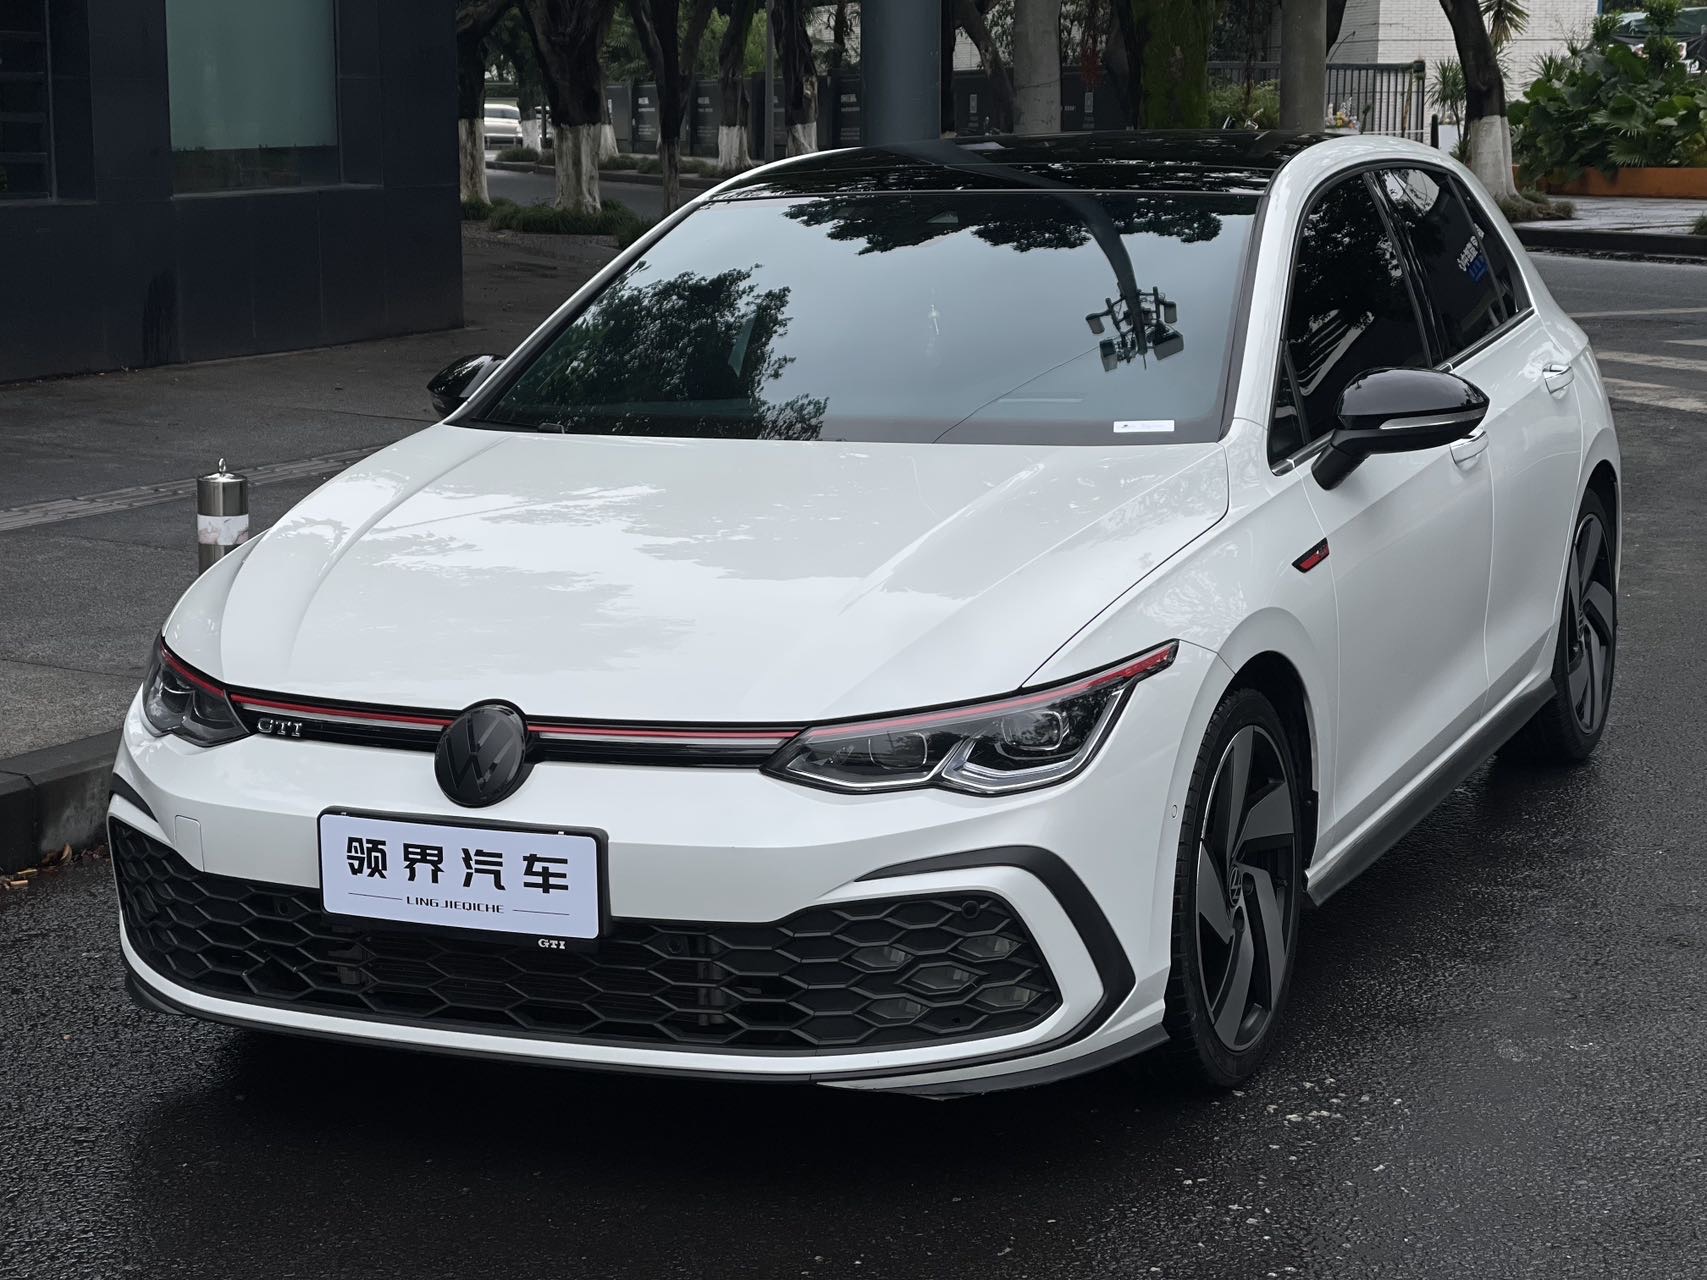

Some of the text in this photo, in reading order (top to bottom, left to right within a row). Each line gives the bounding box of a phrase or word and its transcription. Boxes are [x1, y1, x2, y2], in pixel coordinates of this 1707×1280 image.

[256, 717, 303, 738] GTI
[346, 836, 569, 894] 领界汽车
[538, 938, 566, 950] GTI
